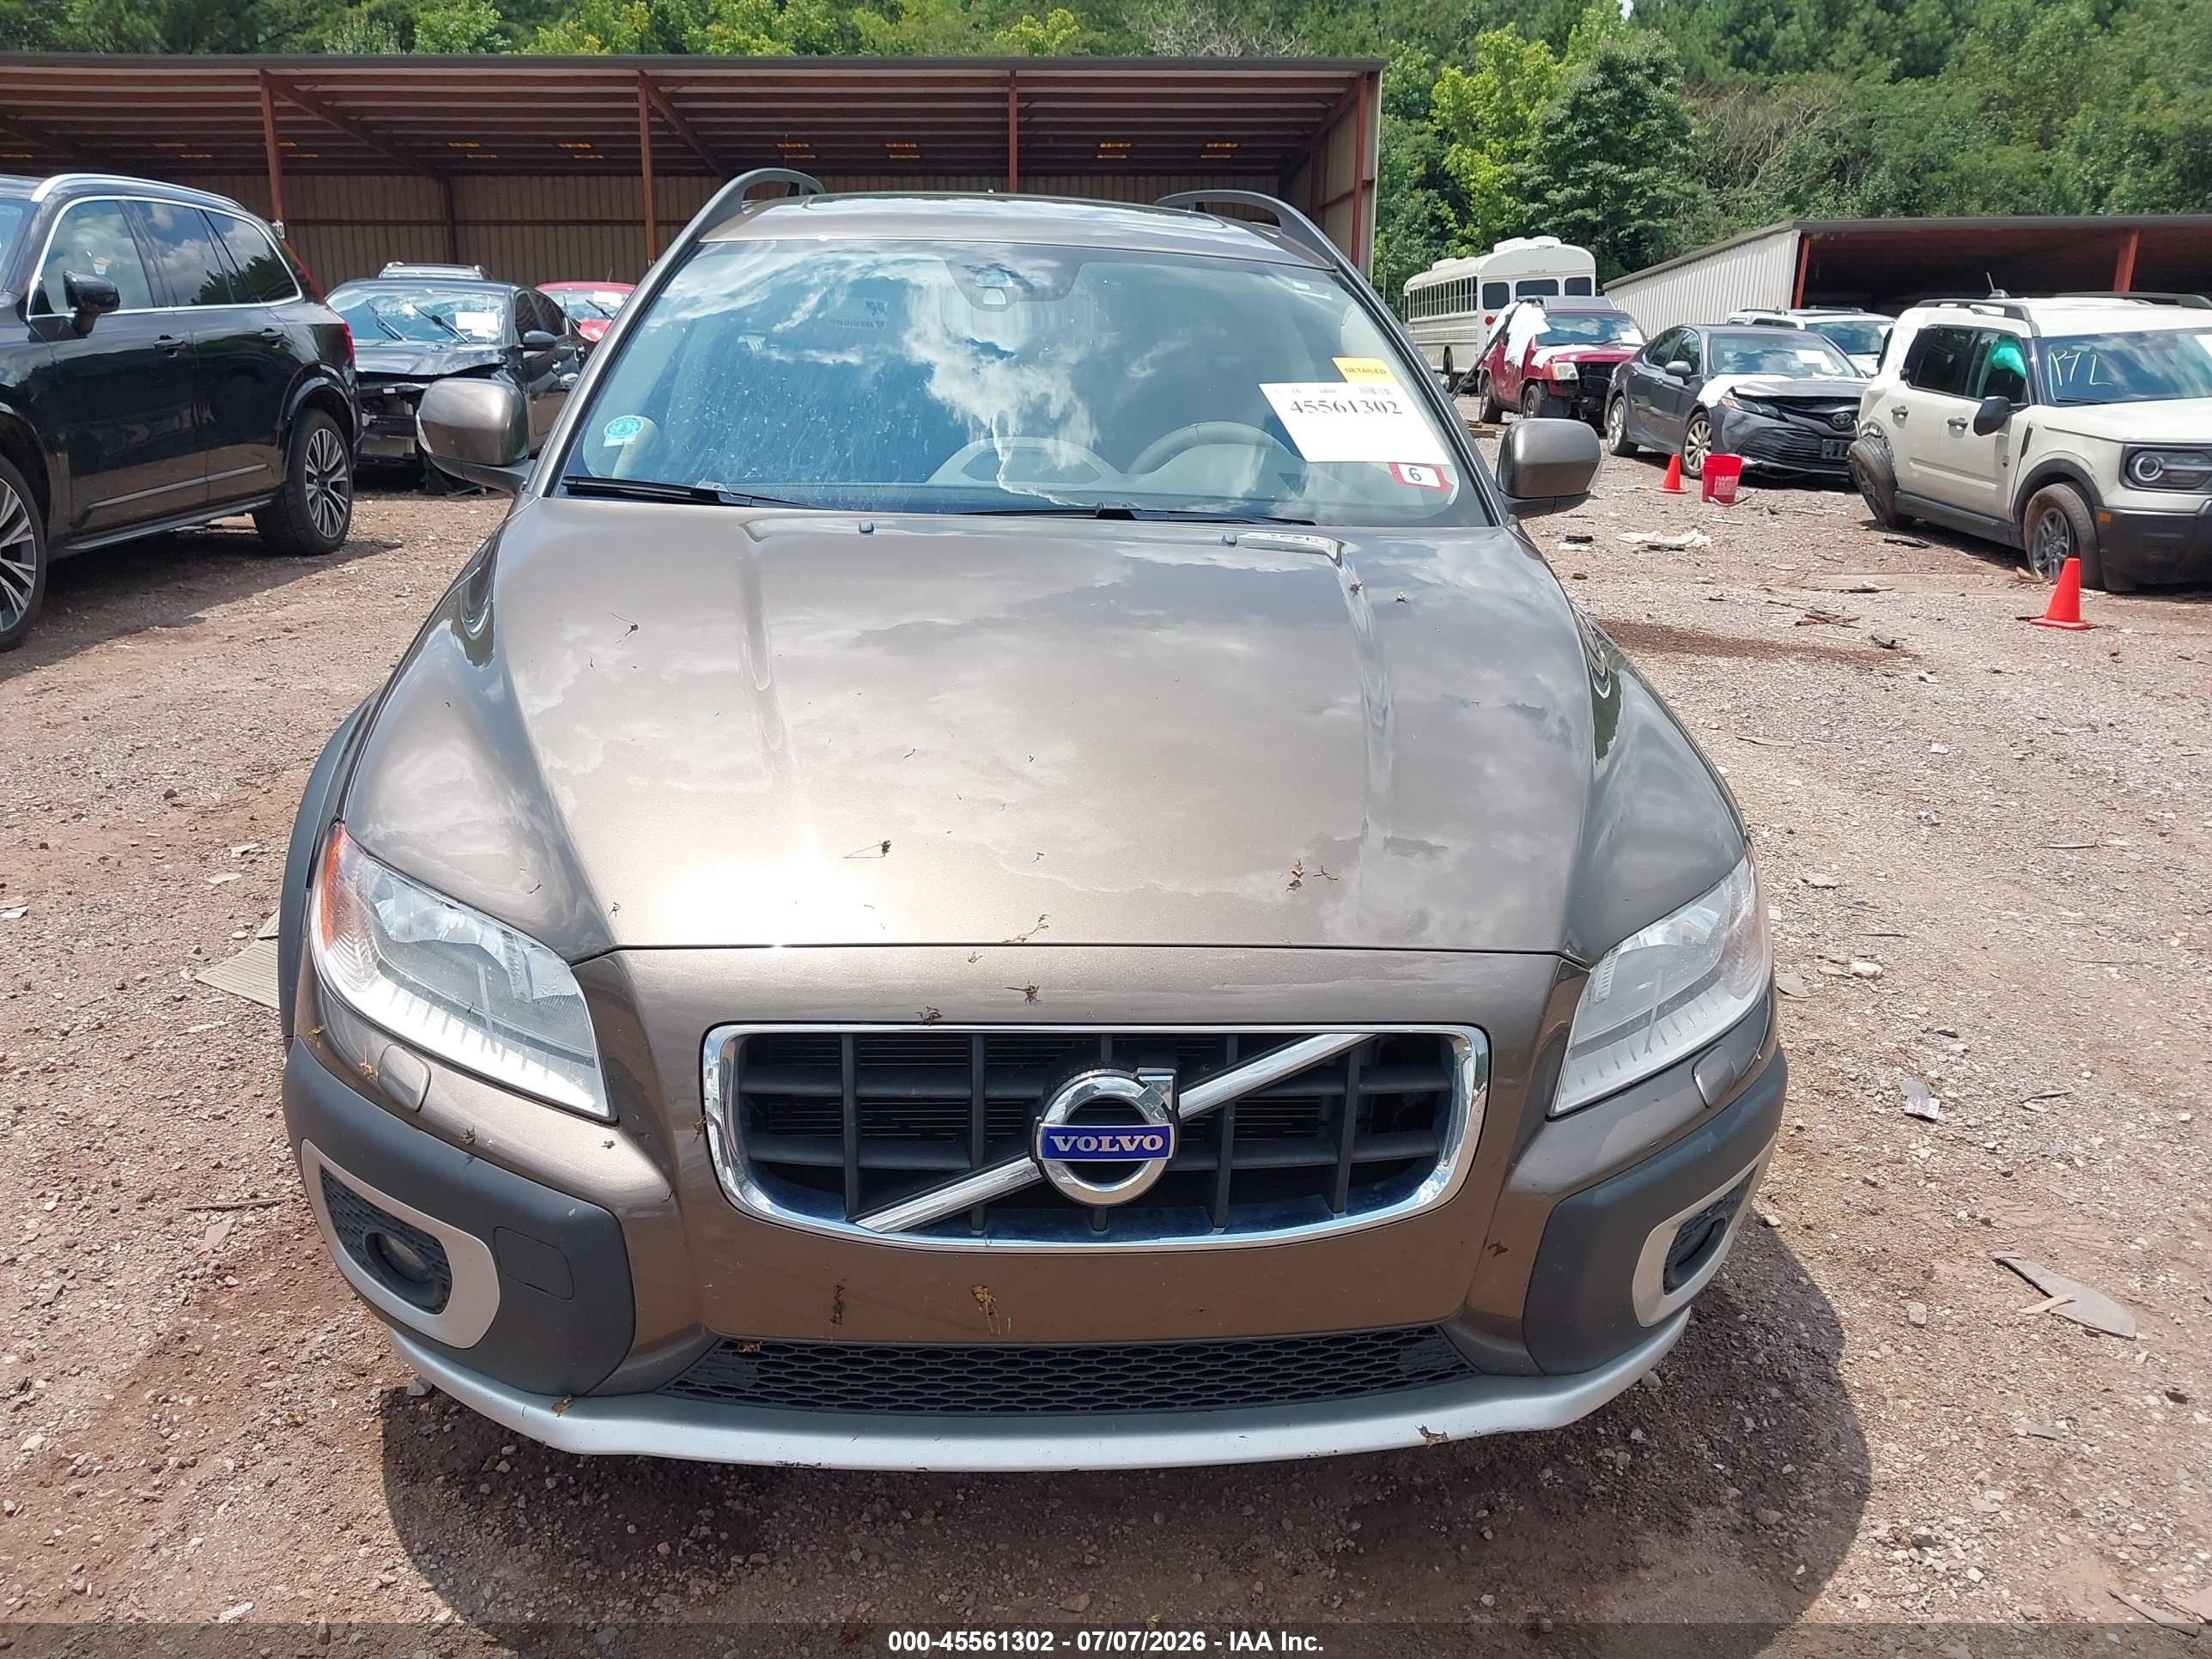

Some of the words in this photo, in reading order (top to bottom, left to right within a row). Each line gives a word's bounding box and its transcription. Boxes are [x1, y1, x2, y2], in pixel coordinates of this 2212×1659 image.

[1291, 400, 1402, 415] 45561302
[1408, 467, 1422, 481] 6
[1049, 1134, 1164, 1152] VOLVO
